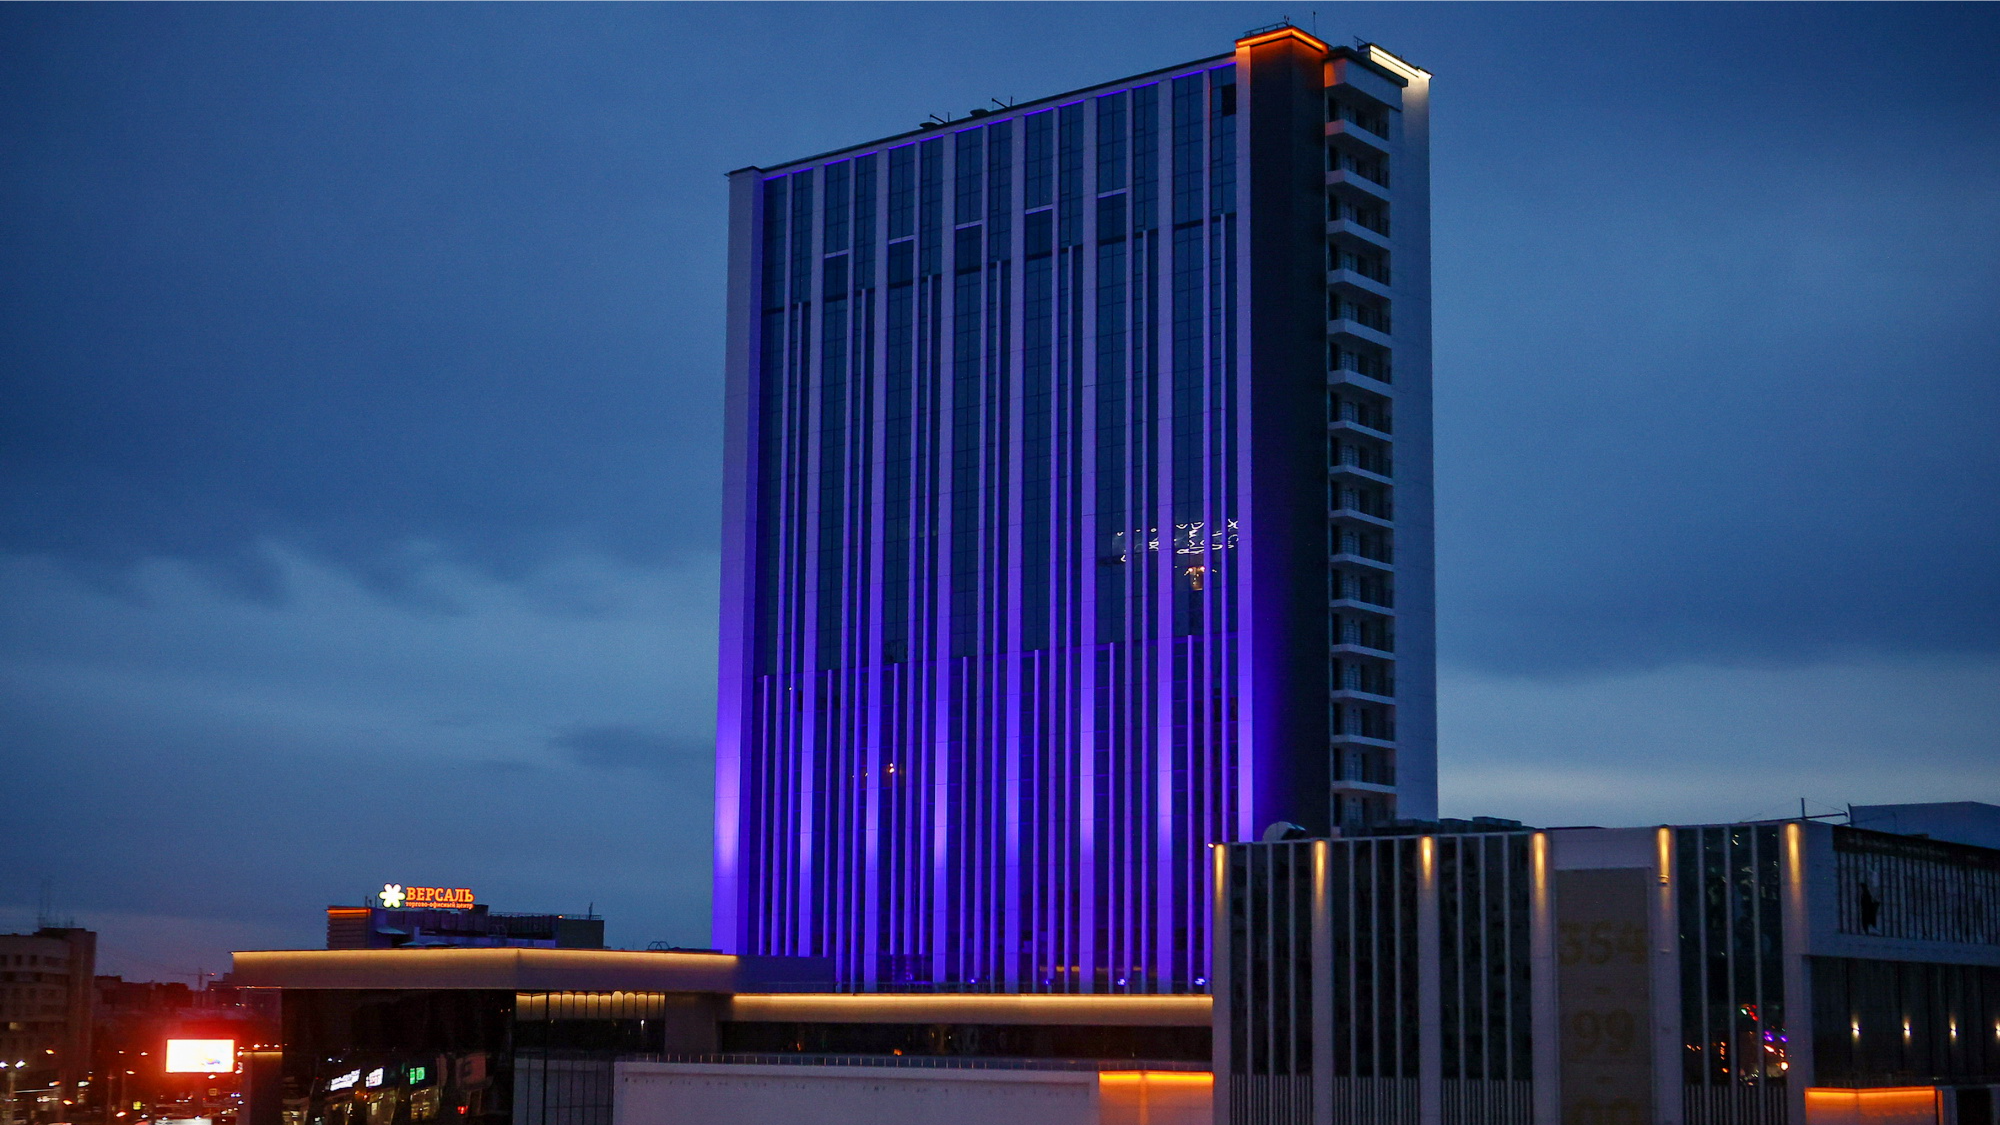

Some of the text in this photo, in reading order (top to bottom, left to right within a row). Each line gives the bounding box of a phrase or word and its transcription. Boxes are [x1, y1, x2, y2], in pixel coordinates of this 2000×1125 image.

[405, 886, 474, 902] ВЕРСАЛЬ
[456, 902, 474, 910] центр
[1559, 921, 1647, 965] 354
[1571, 1008, 1635, 1057] 99
